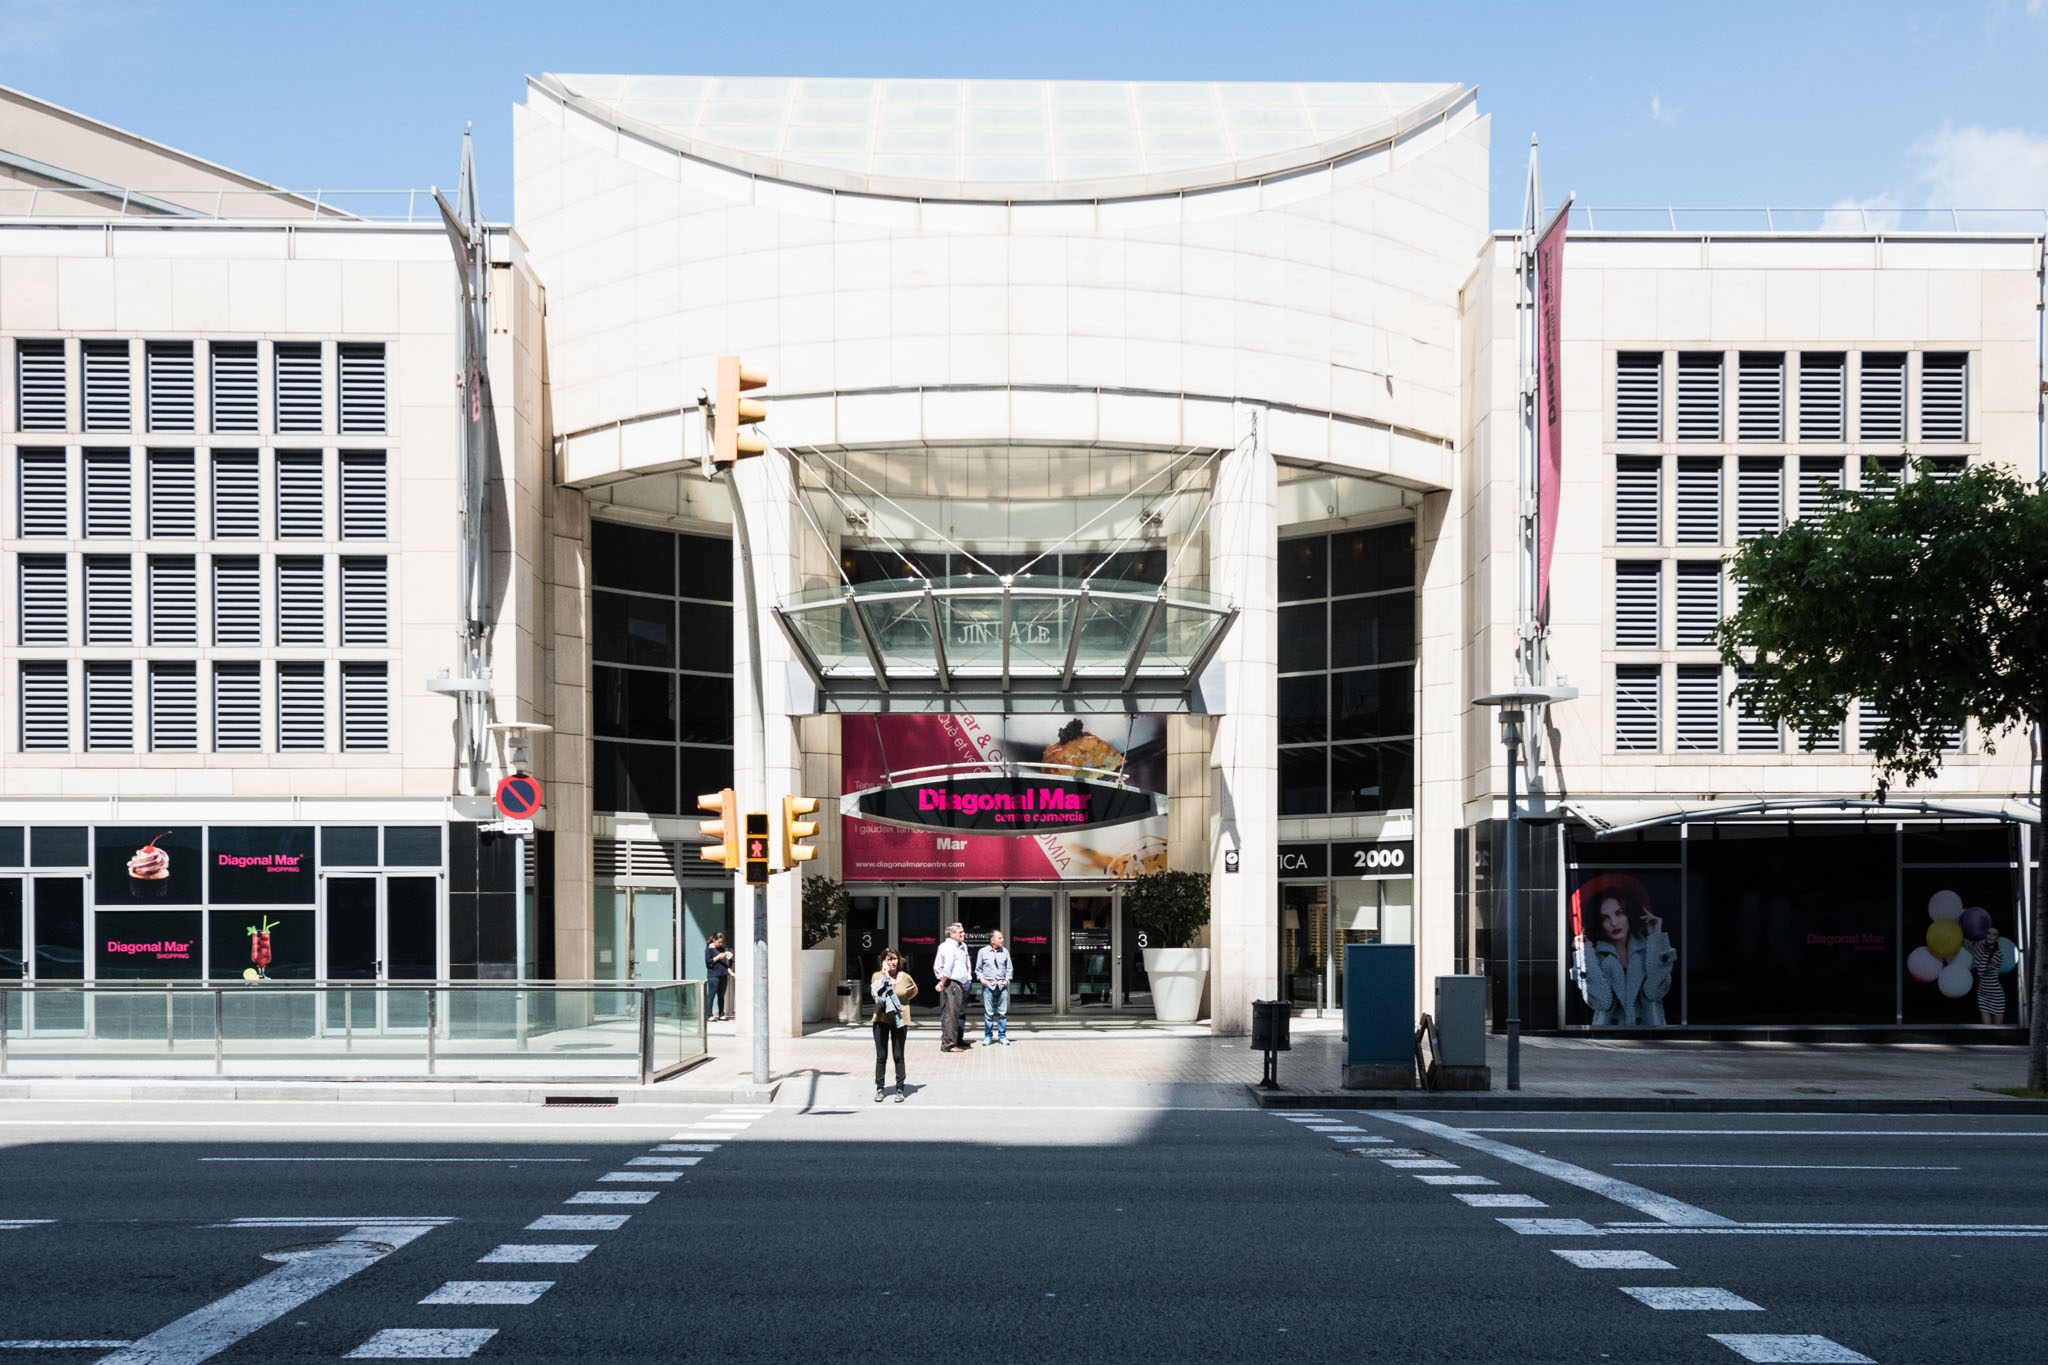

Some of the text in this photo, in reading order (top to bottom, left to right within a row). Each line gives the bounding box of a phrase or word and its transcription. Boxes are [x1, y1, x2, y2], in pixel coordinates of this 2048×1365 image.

[960, 714, 980, 731] ar
[977, 734, 991, 749] &
[954, 738, 968, 751] et
[918, 788, 1091, 815] Diagonal Mar
[995, 811, 1089, 822] centre comercial
[936, 837, 968, 850] Mar
[218, 854, 273, 867] Diagonal
[855, 861, 966, 869] www.diagonalmarcentre.com
[1278, 849, 1405, 870] ICA 2000
[862, 935, 872, 948] 3
[1137, 933, 1148, 948] 3
[1807, 932, 1885, 946] Diagonal Mar
[107, 941, 162, 954] Diagonal
